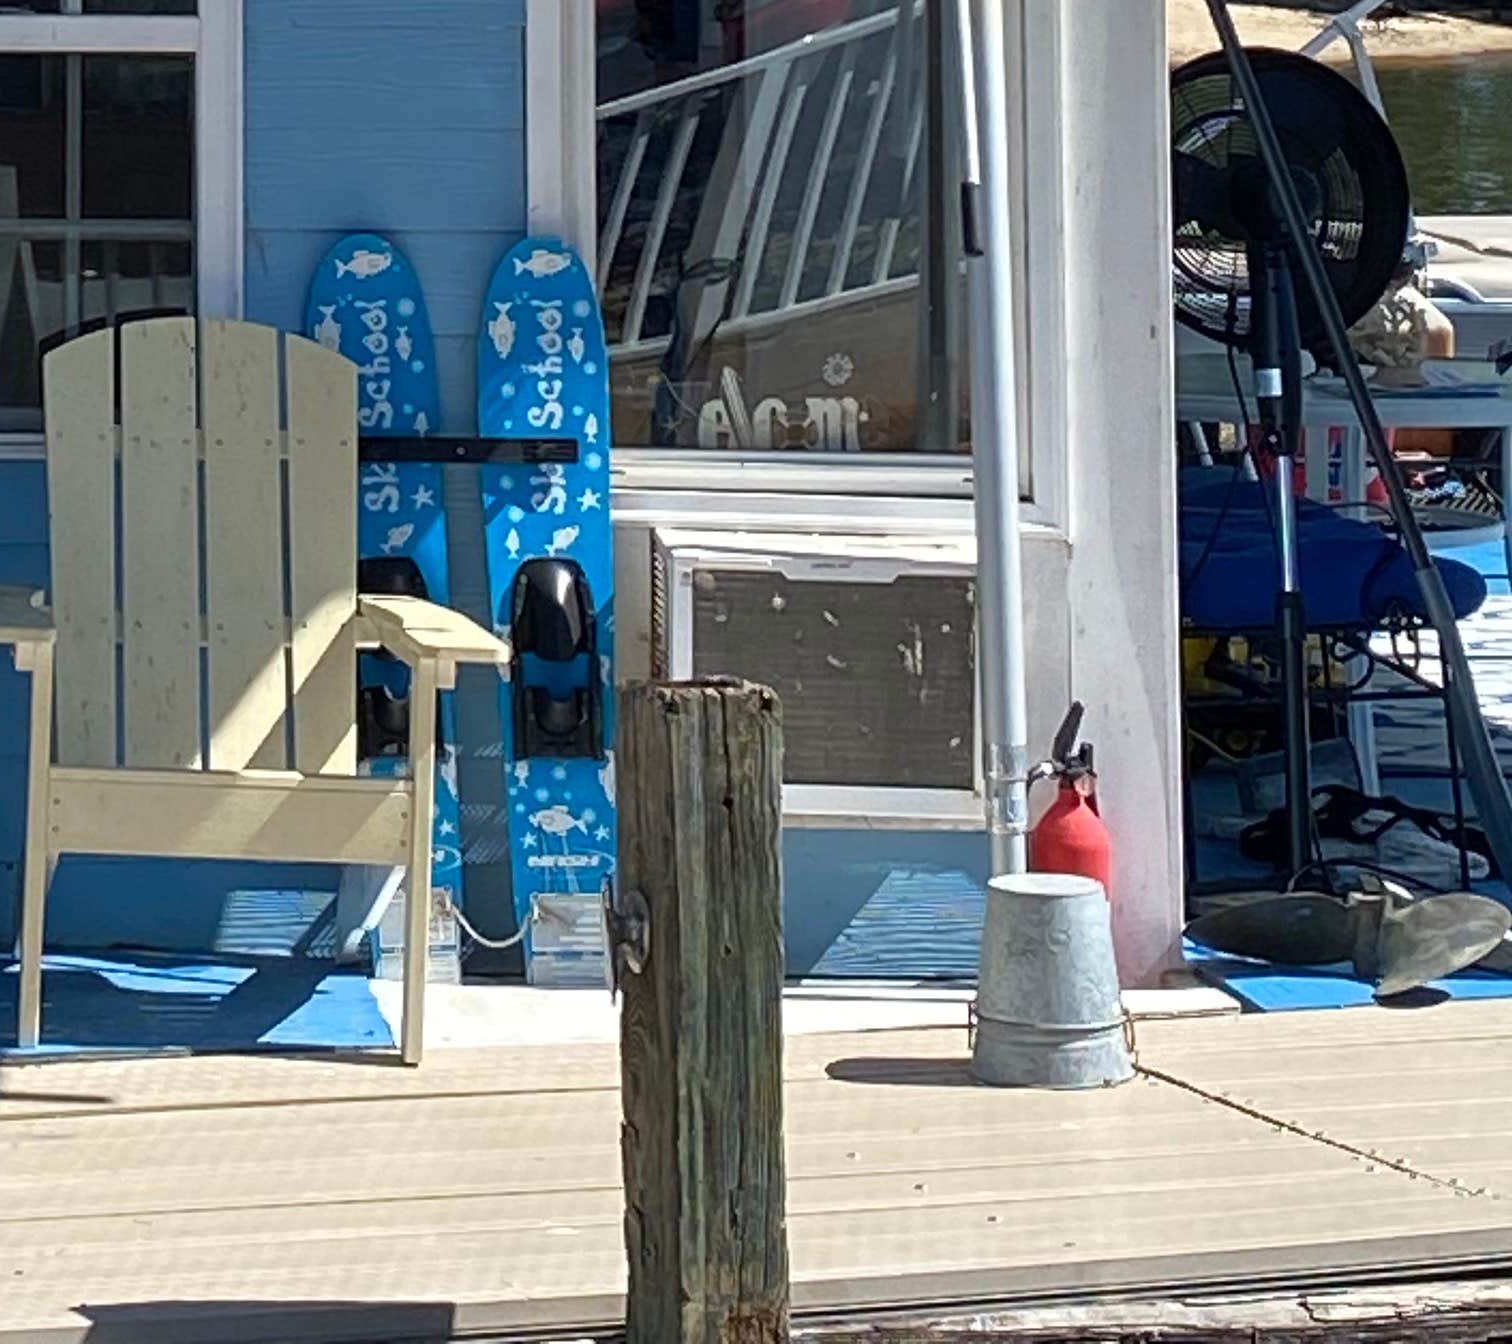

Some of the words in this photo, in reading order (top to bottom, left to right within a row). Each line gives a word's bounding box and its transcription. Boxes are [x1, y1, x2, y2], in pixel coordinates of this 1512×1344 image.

[354, 299, 394, 430] School
[521, 299, 564, 430] School
[529, 463, 568, 515] Sk
